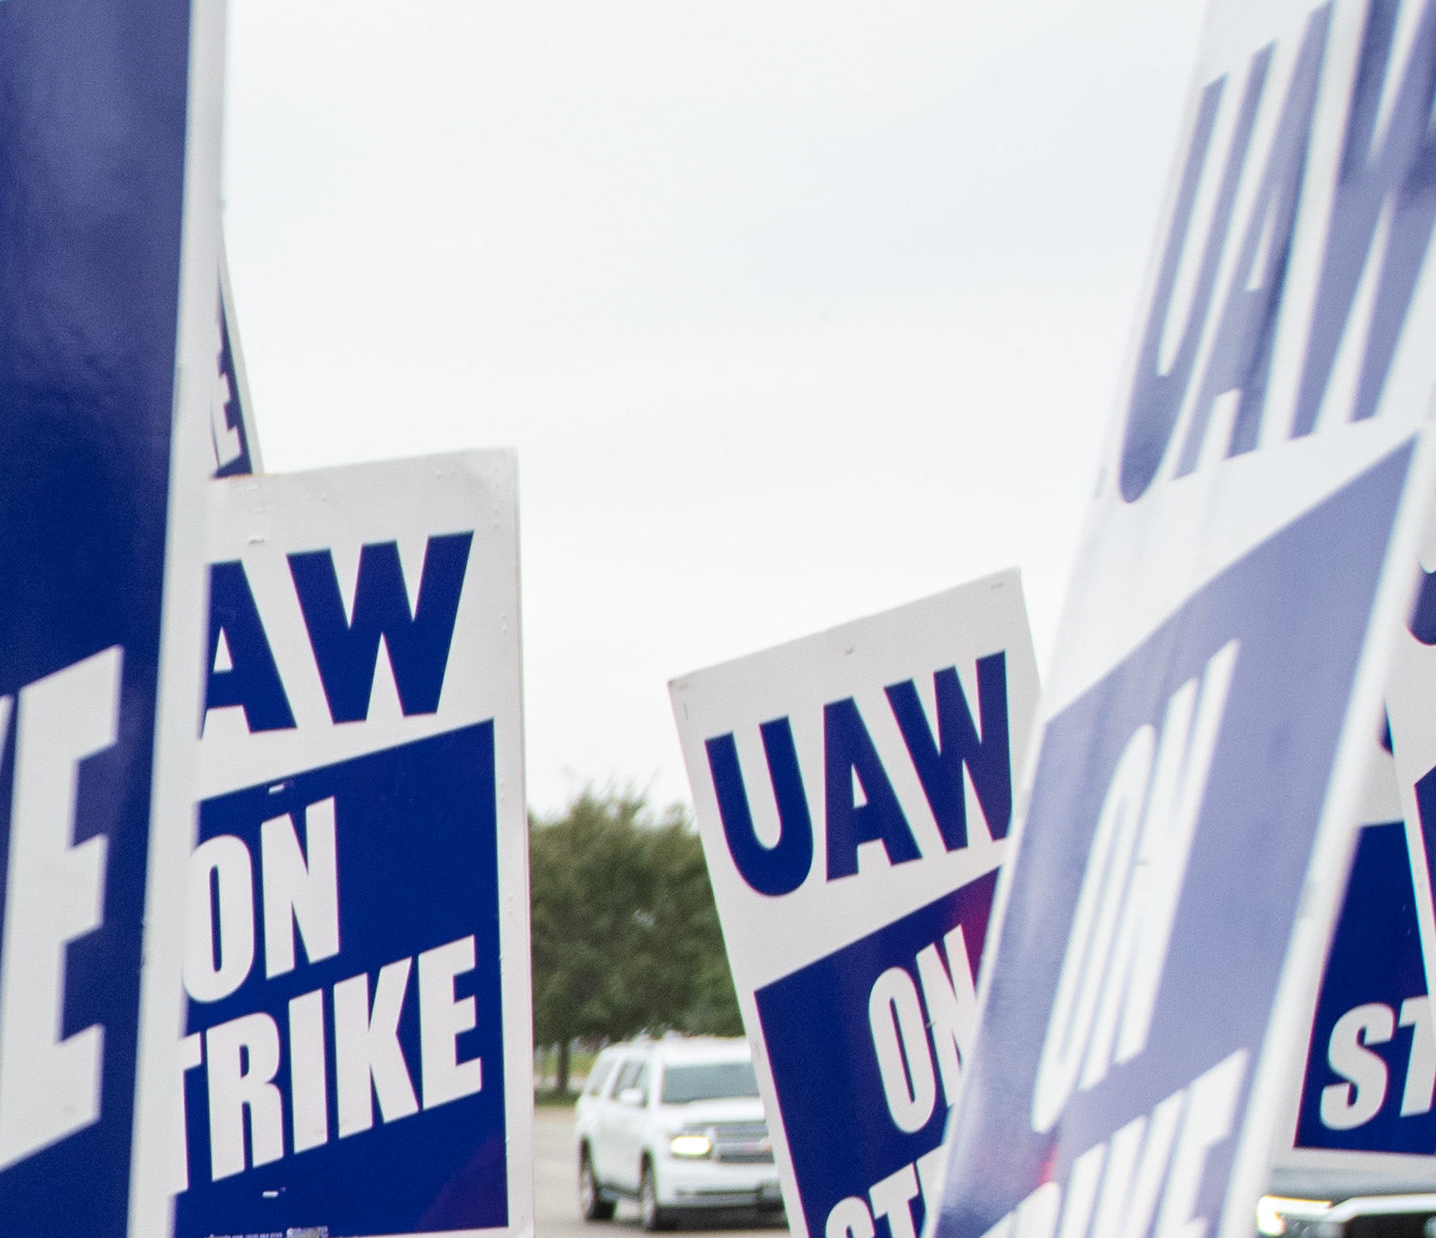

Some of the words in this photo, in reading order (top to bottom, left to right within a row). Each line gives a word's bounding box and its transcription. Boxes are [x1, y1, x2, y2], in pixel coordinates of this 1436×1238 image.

[1120, 0, 1436, 503] UAW
[203, 530, 474, 739] AW
[705, 651, 1013, 897] UAW
[1031, 638, 1241, 1135] ON
[183, 796, 340, 1003] ON
[177, 934, 482, 1194] RIKE
[869, 924, 979, 1134] ON
